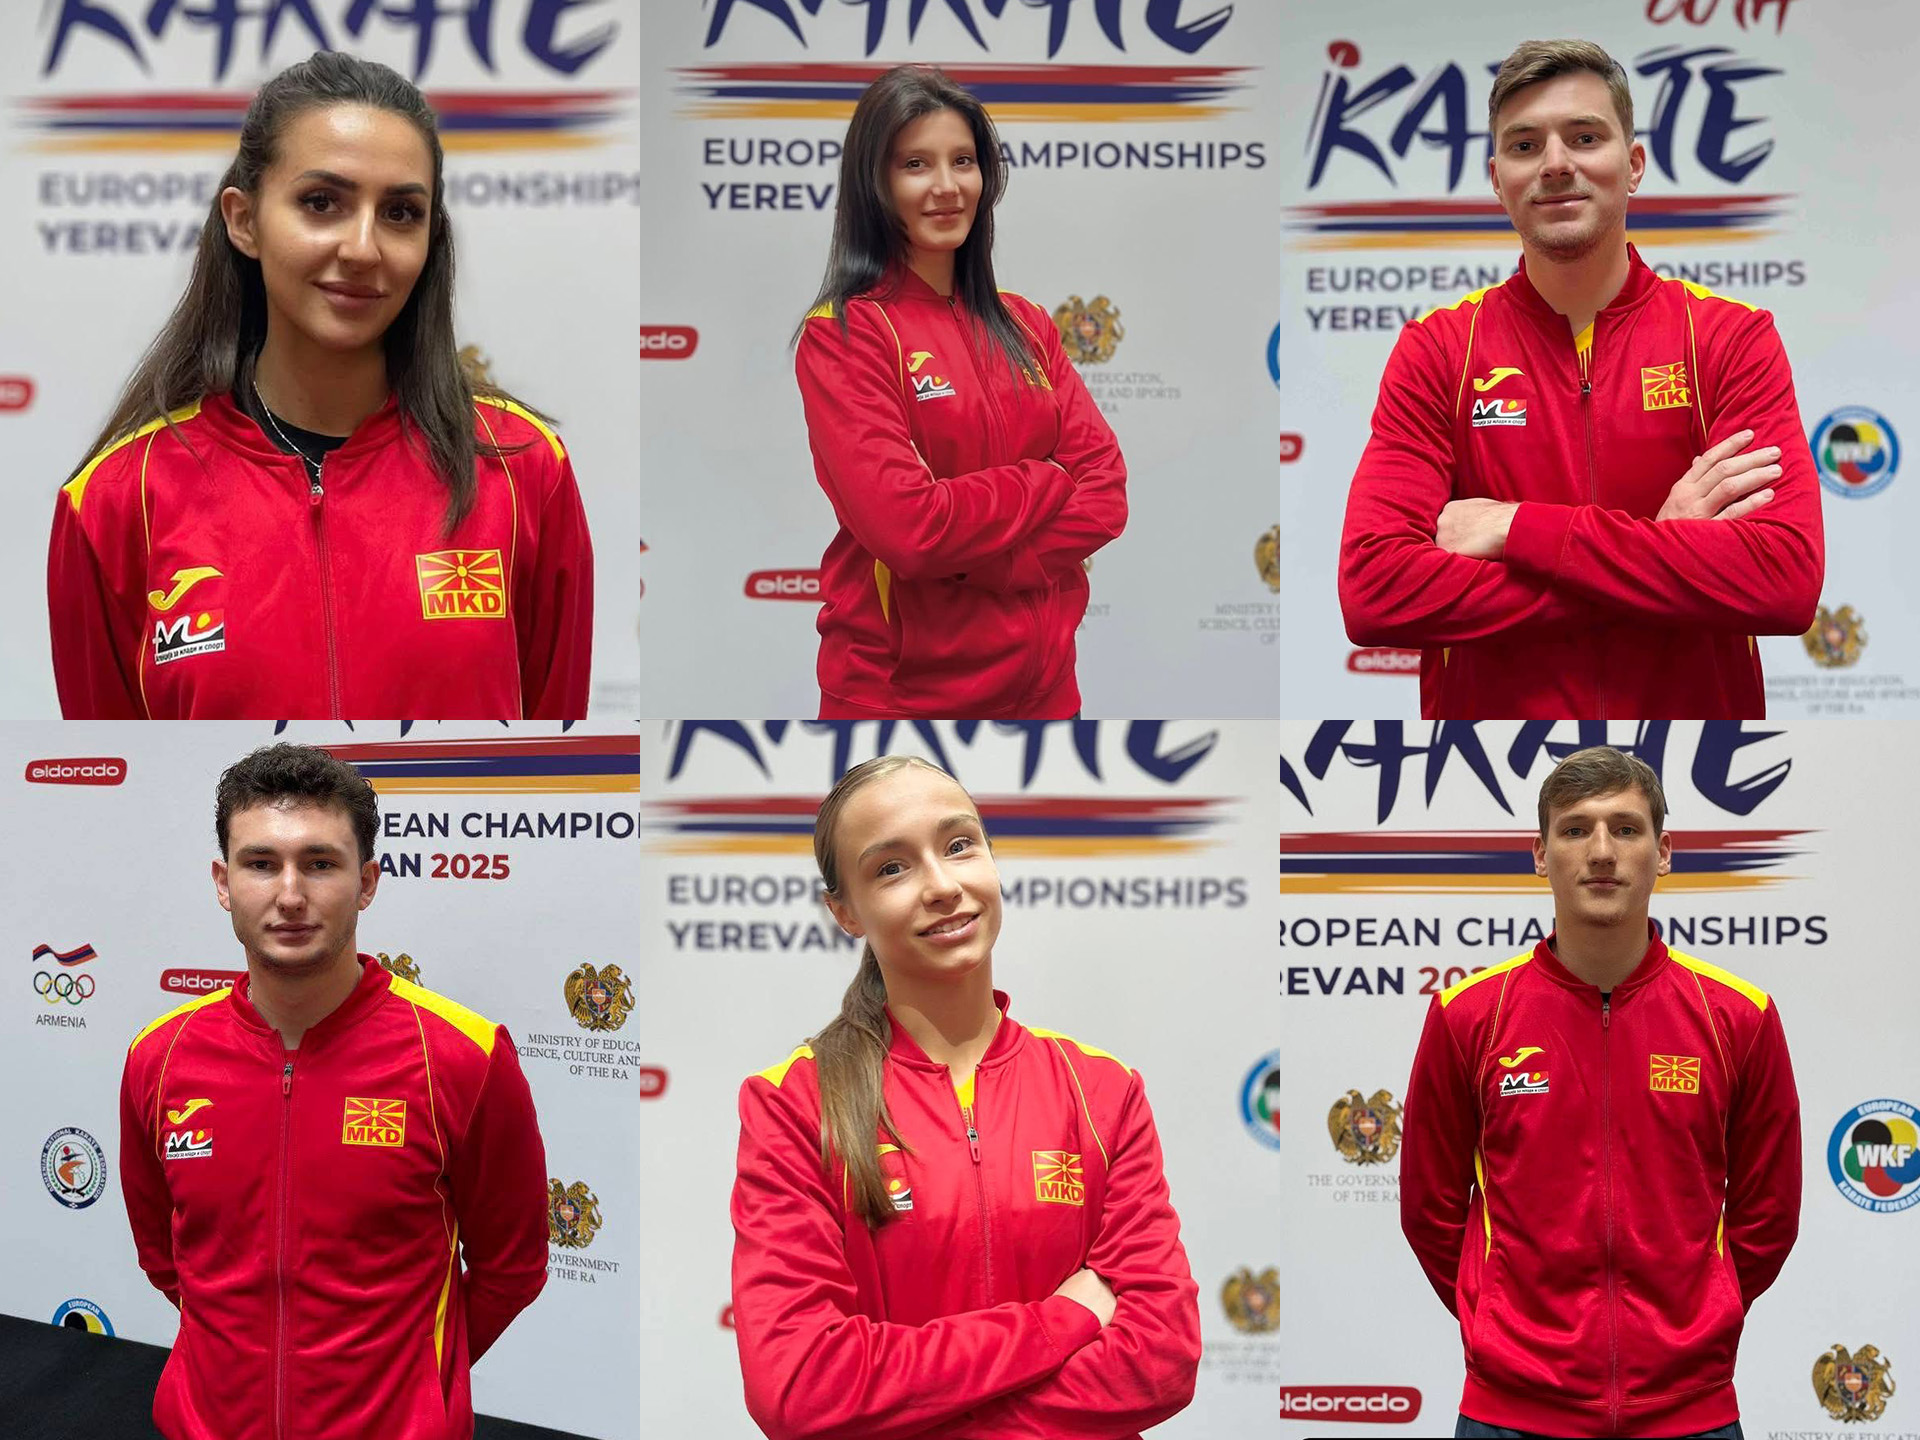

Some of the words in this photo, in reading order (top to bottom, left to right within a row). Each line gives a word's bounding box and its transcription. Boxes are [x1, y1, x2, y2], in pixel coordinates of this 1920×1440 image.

[701, 182, 833, 210] YEREV
[1307, 266, 1500, 292] EUROPEAN
[427, 592, 501, 614] MKD
[32, 764, 119, 778] eldorado
[461, 812, 640, 839] CHAMPIO
[430, 853, 510, 880] 2025
[1280, 967, 1404, 995] EVAN
[36, 1014, 87, 1028] ARMENIA
[528, 1034, 581, 1047] MINISTRY
[585, 1038, 600, 1049] OF
[563, 1050, 615, 1064] CULTURE
[569, 1065, 584, 1076] OF
[587, 1066, 609, 1078] THE
[612, 1069, 629, 1080] RA
[1652, 1077, 1696, 1091] MKD
[1857, 1100, 1915, 1118] EUROPEAN
[346, 1126, 401, 1143] MKD
[1856, 1144, 1911, 1168] WKF
[1307, 1175, 1332, 1187] THE
[1040, 1182, 1084, 1202] MKD
[1333, 1191, 1350, 1202] OF
[1353, 1191, 1378, 1202] THE
[1837, 1180, 1874, 1210] KARATE
[555, 1267, 578, 1280] THE
[580, 1271, 597, 1284] RA
